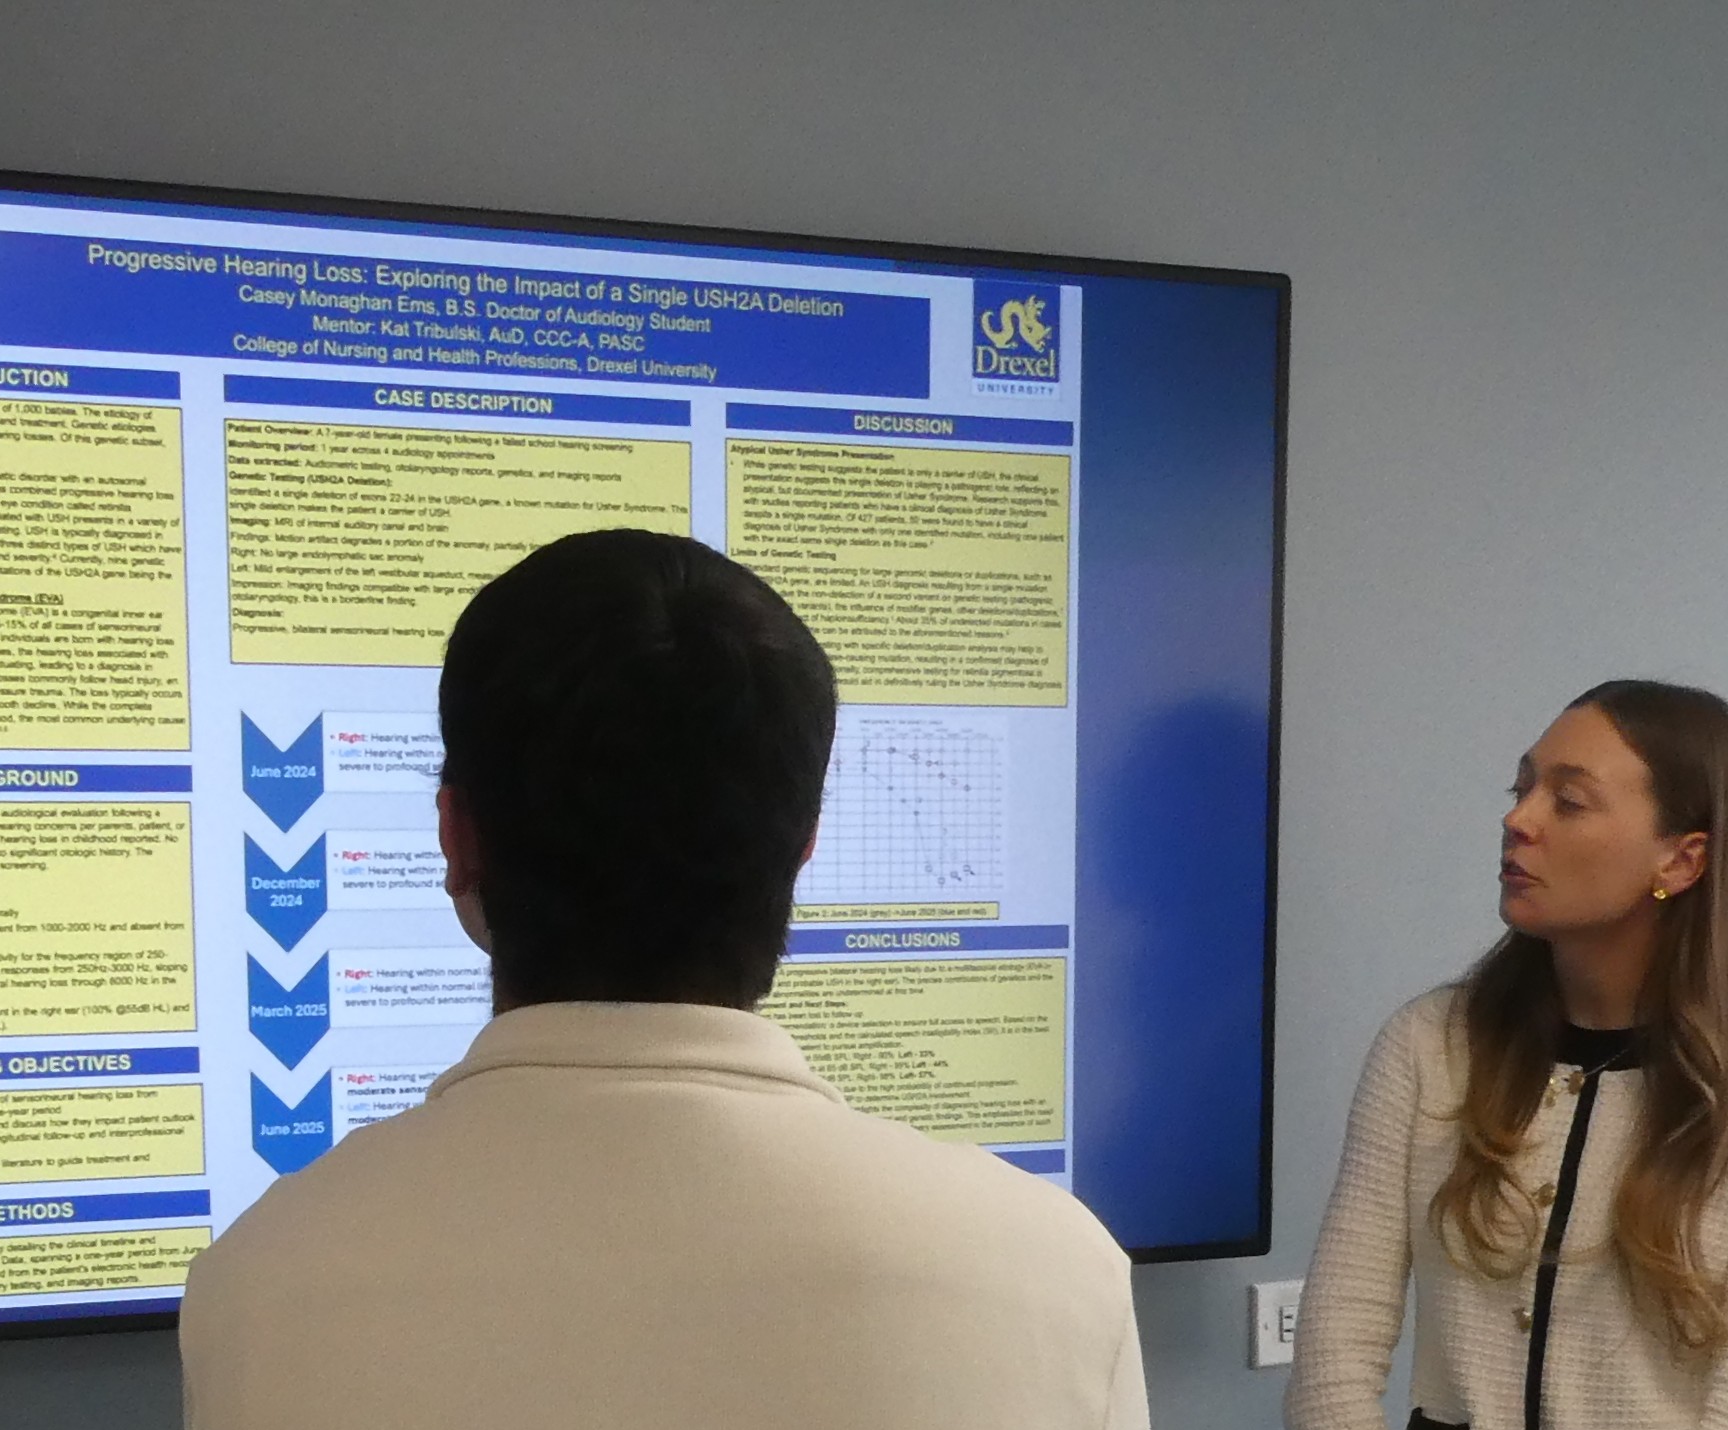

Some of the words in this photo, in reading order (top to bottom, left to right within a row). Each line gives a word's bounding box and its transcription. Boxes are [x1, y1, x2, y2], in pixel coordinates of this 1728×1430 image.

[88, 244, 217, 279] Progressive
[223, 253, 307, 285] Hearing
[313, 259, 367, 284] Loss:
[375, 263, 471, 296] Exploring
[475, 270, 507, 293] the
[514, 273, 580, 303] Impact
[585, 278, 605, 300] of
[610, 285, 622, 301] a
[628, 281, 688, 311] Single
[693, 285, 764, 310] USH2A
[768, 290, 843, 316] Deletion
[238, 285, 295, 310] Casey
[299, 289, 392, 316] Monaghan
[485, 300, 541, 321] Doctor
[544, 304, 562, 322] of
[564, 305, 644, 332] Audiology
[649, 310, 710, 331] Student
[380, 318, 409, 337] Kat
[412, 320, 484, 344] Tribulski,
[488, 324, 528, 347] AuD,
[533, 327, 593, 351] CCC-A,
[598, 331, 644, 351] PASC
[233, 334, 298, 359] College
[300, 337, 320, 356] of
[322, 339, 388, 364] Nursing
[391, 342, 423, 361] and
[428, 344, 480, 365] Health
[484, 348, 582, 373] Professions,
[586, 353, 637, 373] Drexel
[641, 356, 716, 382] University
[975, 345, 1056, 378] Drexel
[977, 382, 1054, 395] UNIVERSITY
[374, 389, 424, 407] CASE
[430, 391, 554, 412] DESCRIPTION
[853, 414, 954, 433] DISCUSSION
[250, 764, 281, 778] June
[283, 763, 316, 777] 2024
[251, 875, 322, 889] December
[269, 893, 302, 906] 2024
[845, 931, 960, 948] CONCLUSIONS
[250, 1003, 292, 1017] March
[295, 1003, 329, 1016] 2025
[7, 1053, 131, 1073] OBJECTIVES
[259, 1121, 290, 1135] June
[292, 1120, 325, 1134] 2025
